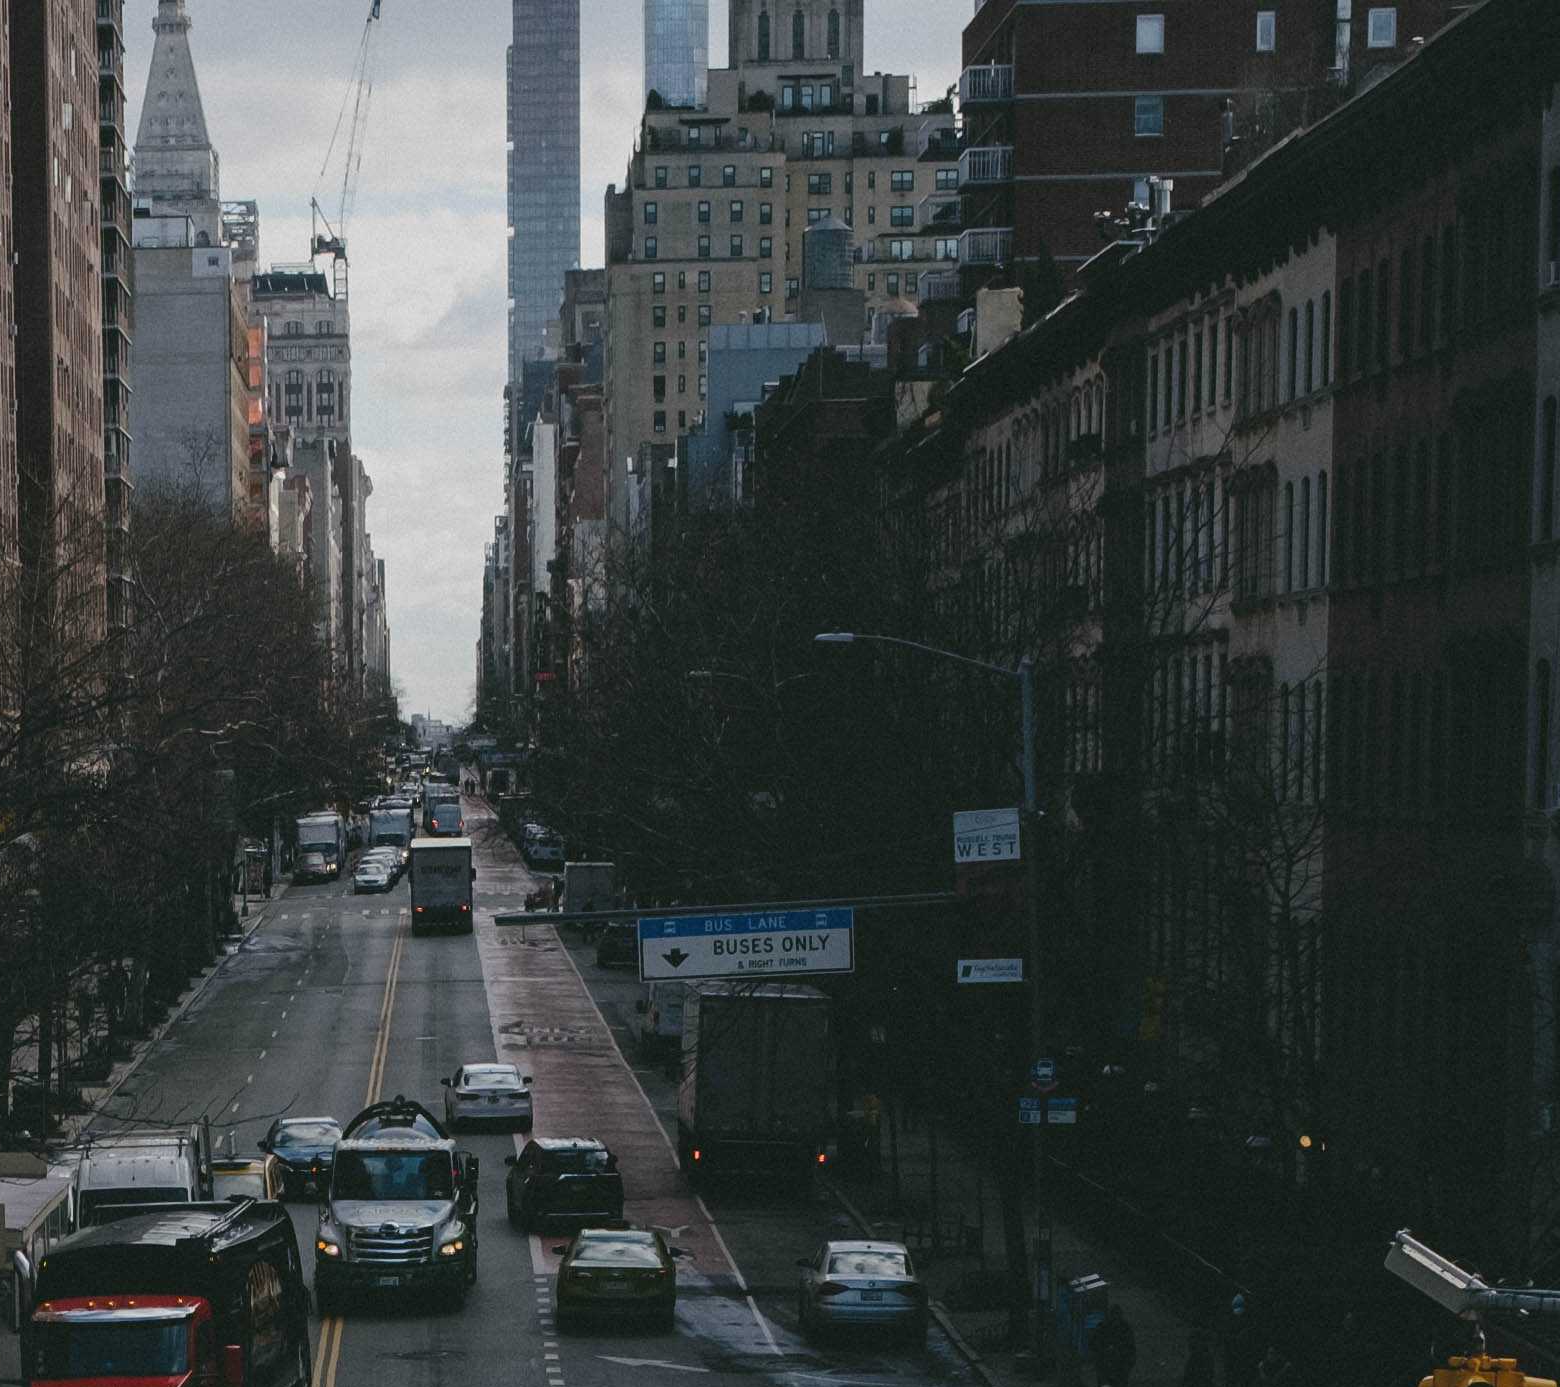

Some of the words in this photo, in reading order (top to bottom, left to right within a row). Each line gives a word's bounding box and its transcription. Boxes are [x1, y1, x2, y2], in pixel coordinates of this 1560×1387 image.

[957, 841, 1016, 857] WEST
[704, 919, 732, 933] BUS
[748, 916, 787, 930] LANE
[713, 938, 774, 956] BUSES
[782, 934, 830, 952] ONLY
[748, 959, 774, 969] RIGHT
